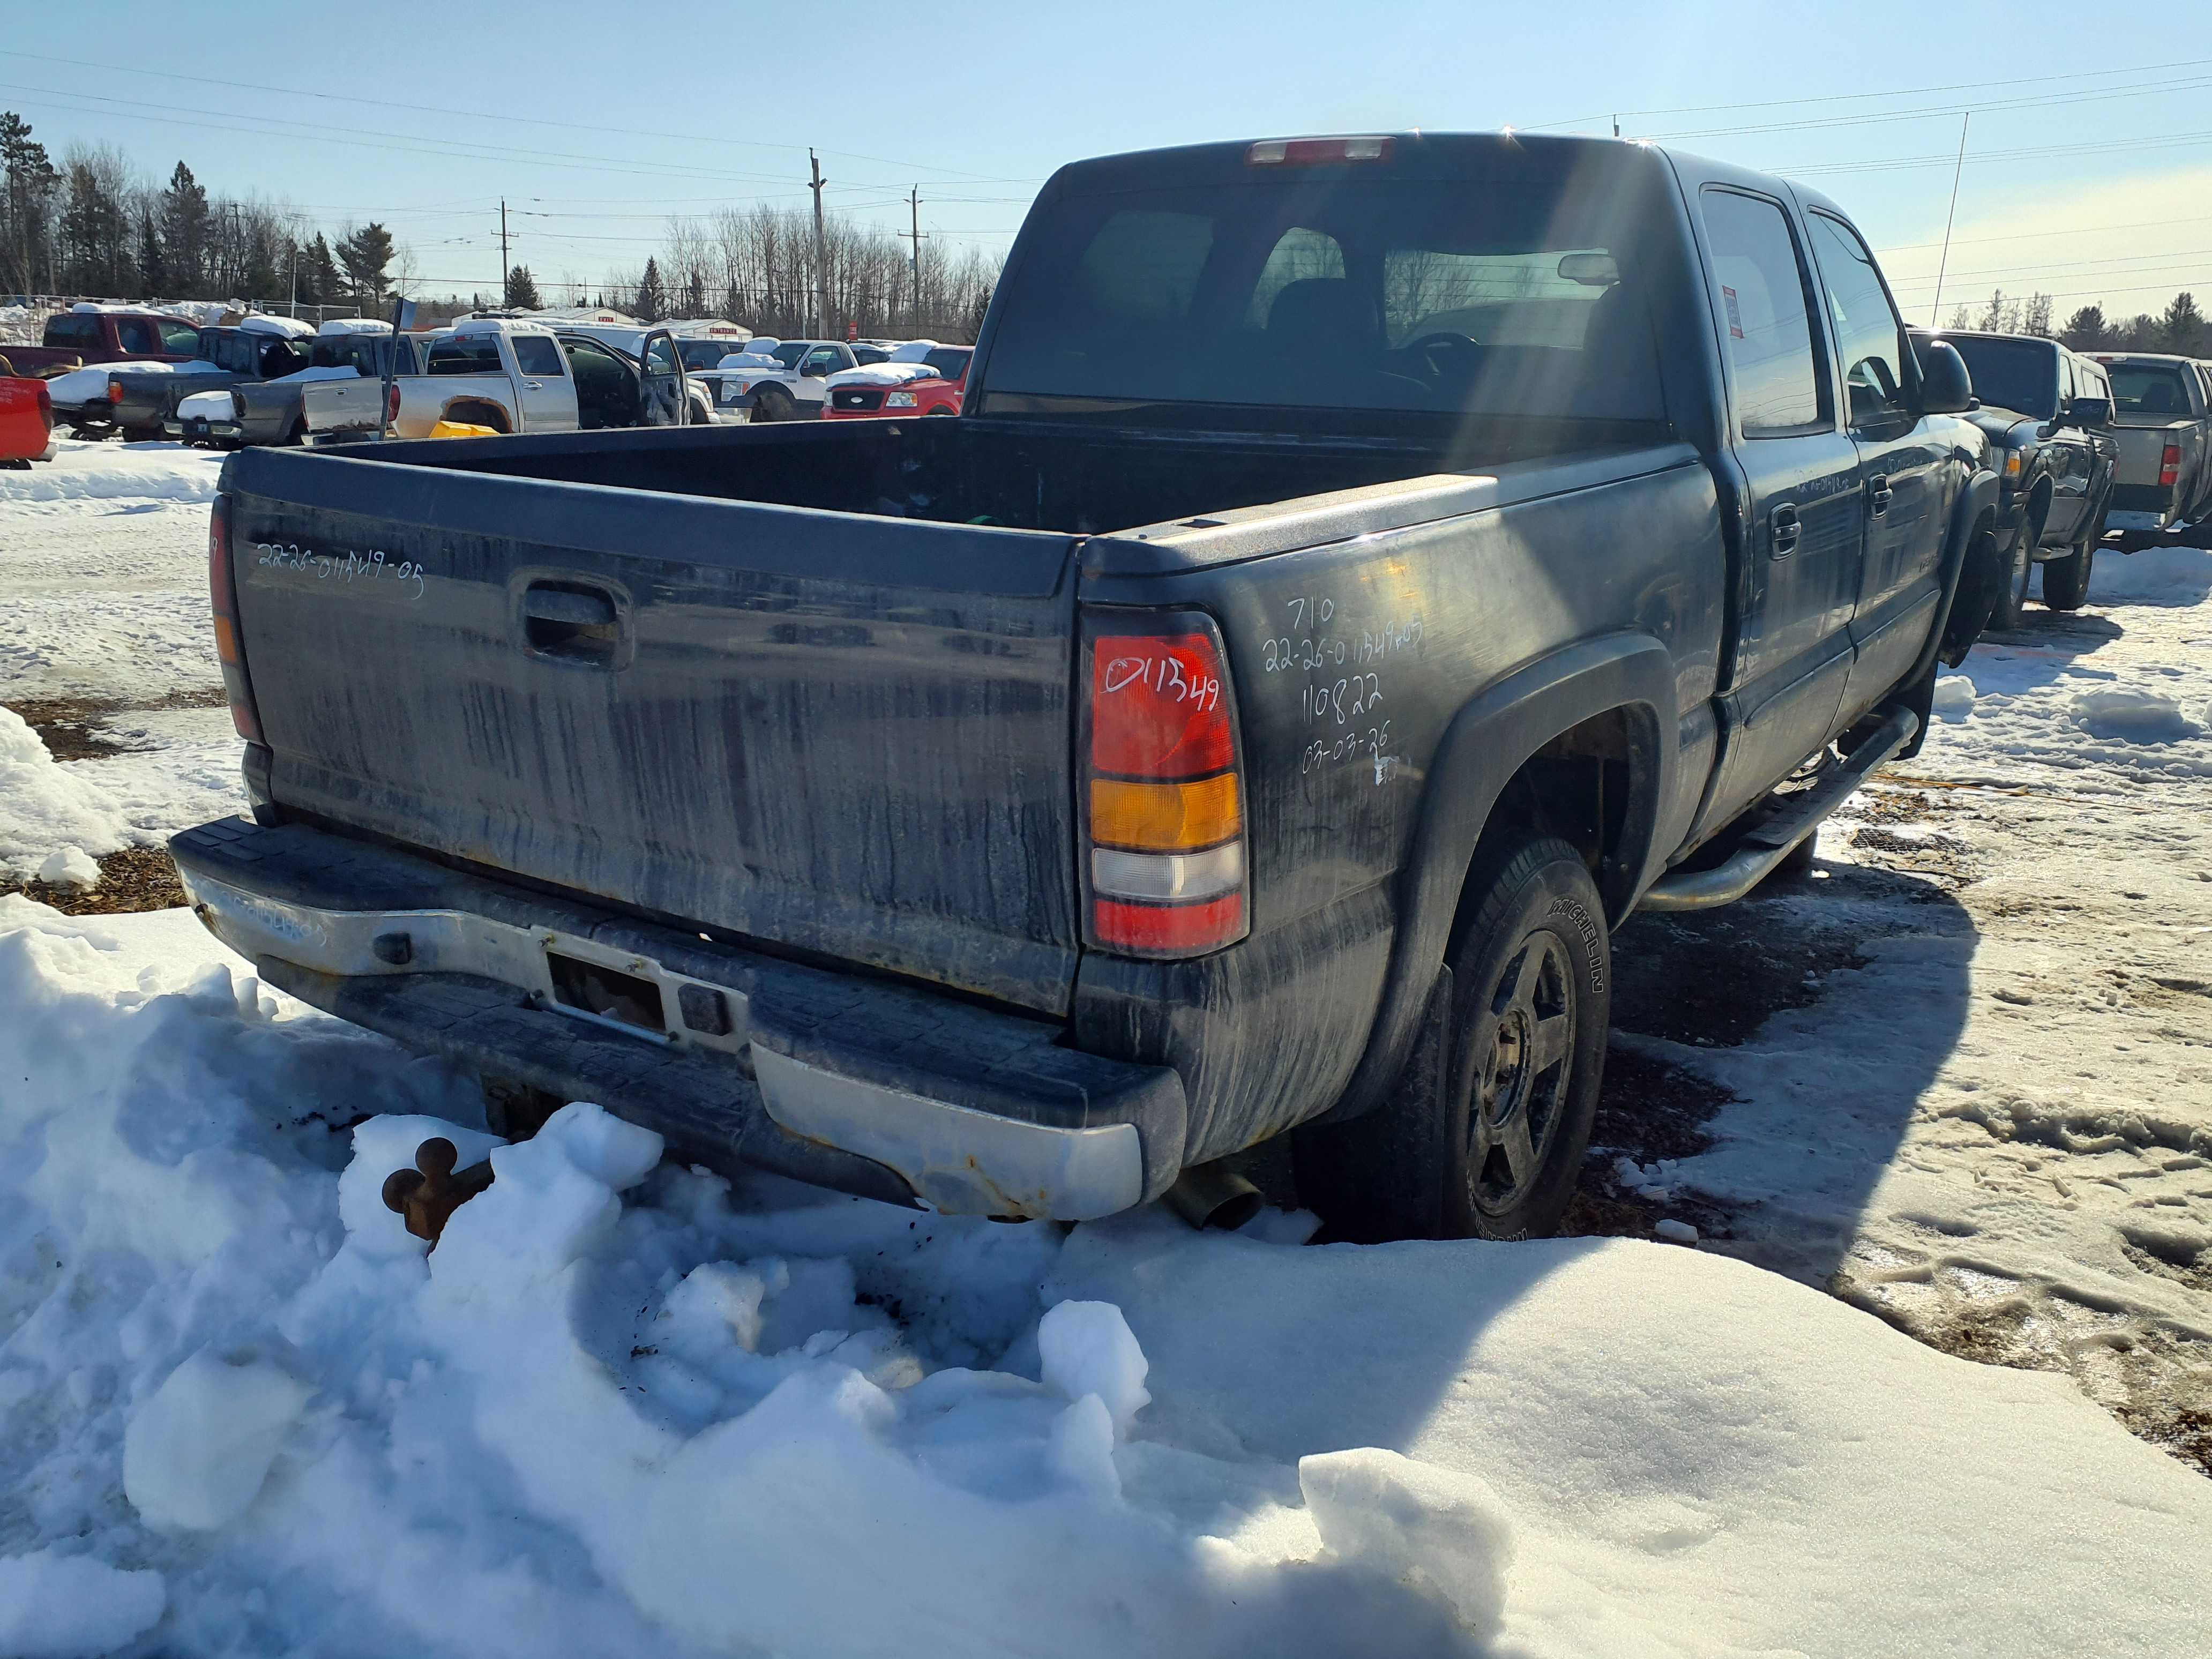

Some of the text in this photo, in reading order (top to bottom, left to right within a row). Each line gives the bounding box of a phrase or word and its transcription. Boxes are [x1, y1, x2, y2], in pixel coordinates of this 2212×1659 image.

[256, 543, 424, 600] 22-26-011549-05
[1287, 596, 1335, 630] 710
[1303, 672, 1383, 725] 110822
[1546, 899, 1604, 993] MICHELIN
